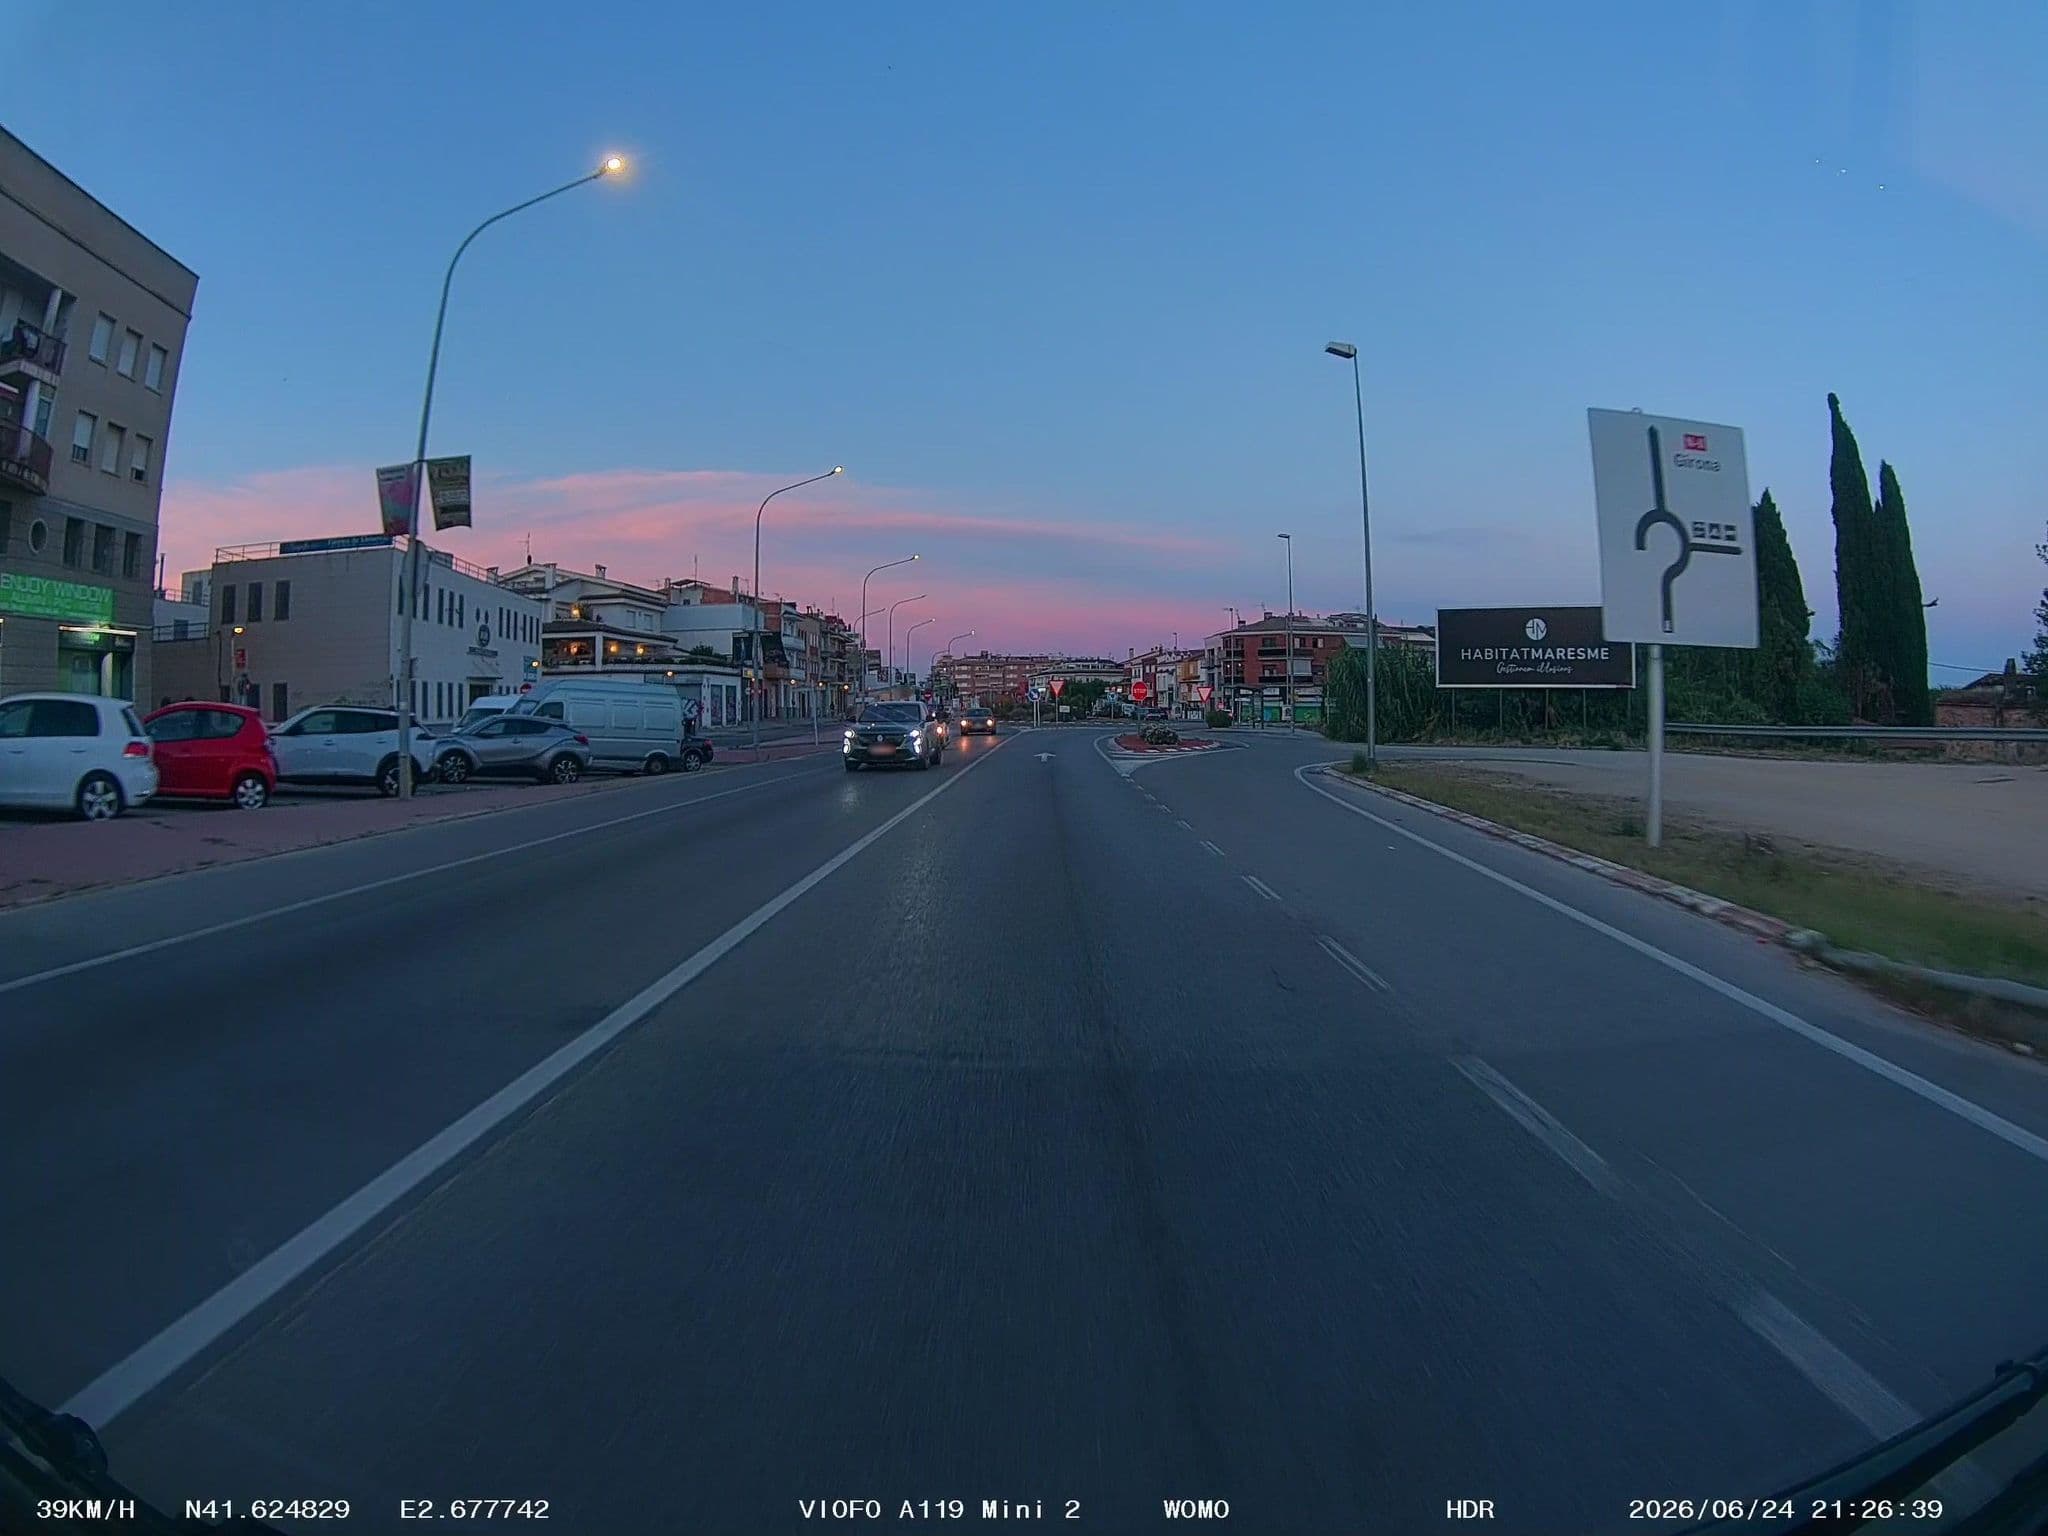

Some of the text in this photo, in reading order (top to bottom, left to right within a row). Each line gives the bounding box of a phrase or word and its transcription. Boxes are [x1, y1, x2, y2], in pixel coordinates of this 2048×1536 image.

[0, 573, 49, 595] ENJOY
[54, 581, 112, 602] WINDOW
[1461, 647, 1610, 660] HABITATMARESME
